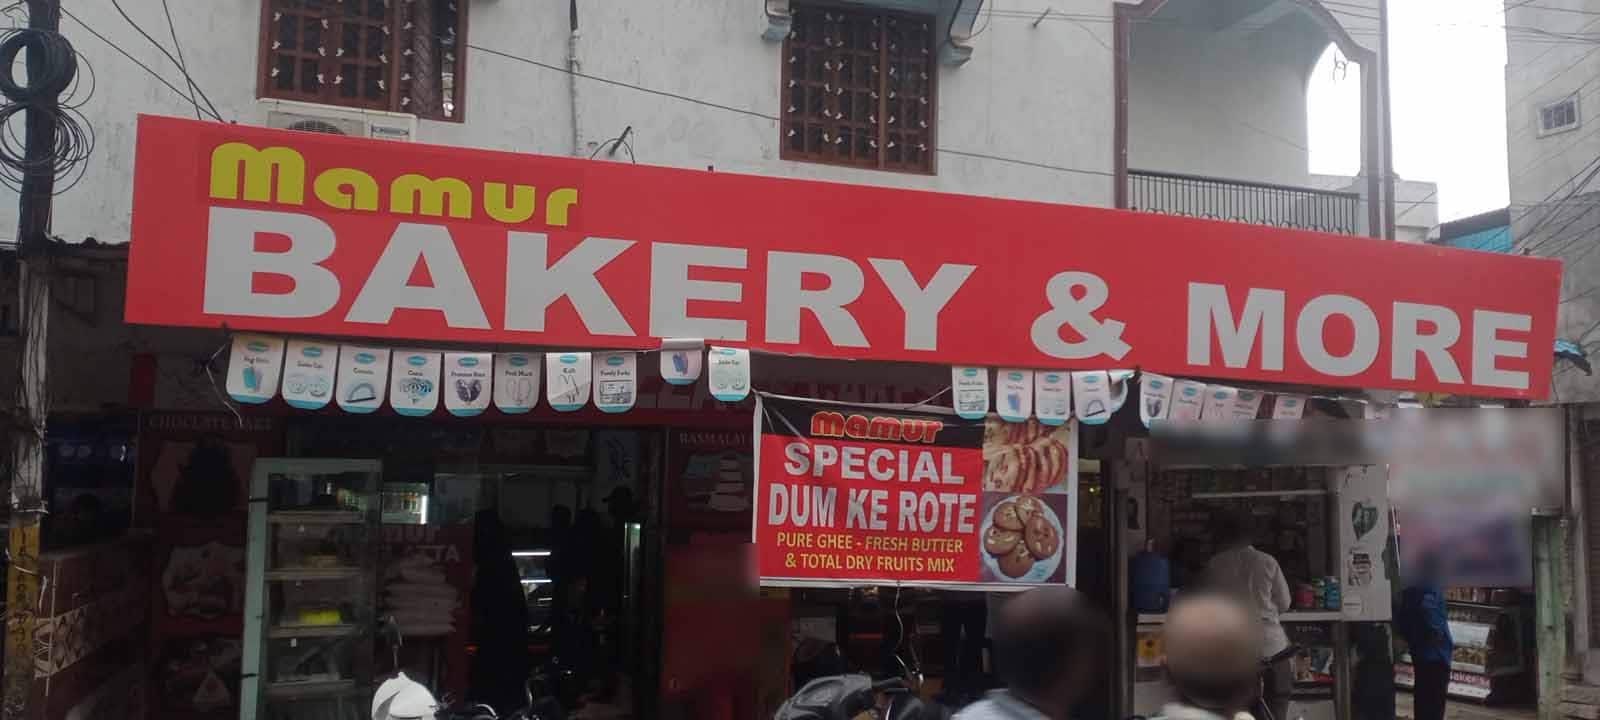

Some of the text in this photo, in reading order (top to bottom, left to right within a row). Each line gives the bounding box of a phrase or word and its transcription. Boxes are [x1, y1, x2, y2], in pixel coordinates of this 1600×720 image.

[204, 206, 1532, 390] BAKERY & MORE
[784, 442, 965, 485] SPECIAL
[768, 483, 977, 534] DUM KE ROTE
[776, 532, 813, 549] PURE
[817, 534, 853, 550] GHEE
[865, 536, 909, 552] FRESH
[912, 537, 964, 553] BUTTER
[785, 552, 955, 573] & TOTAL DRY FRUITS MIX
